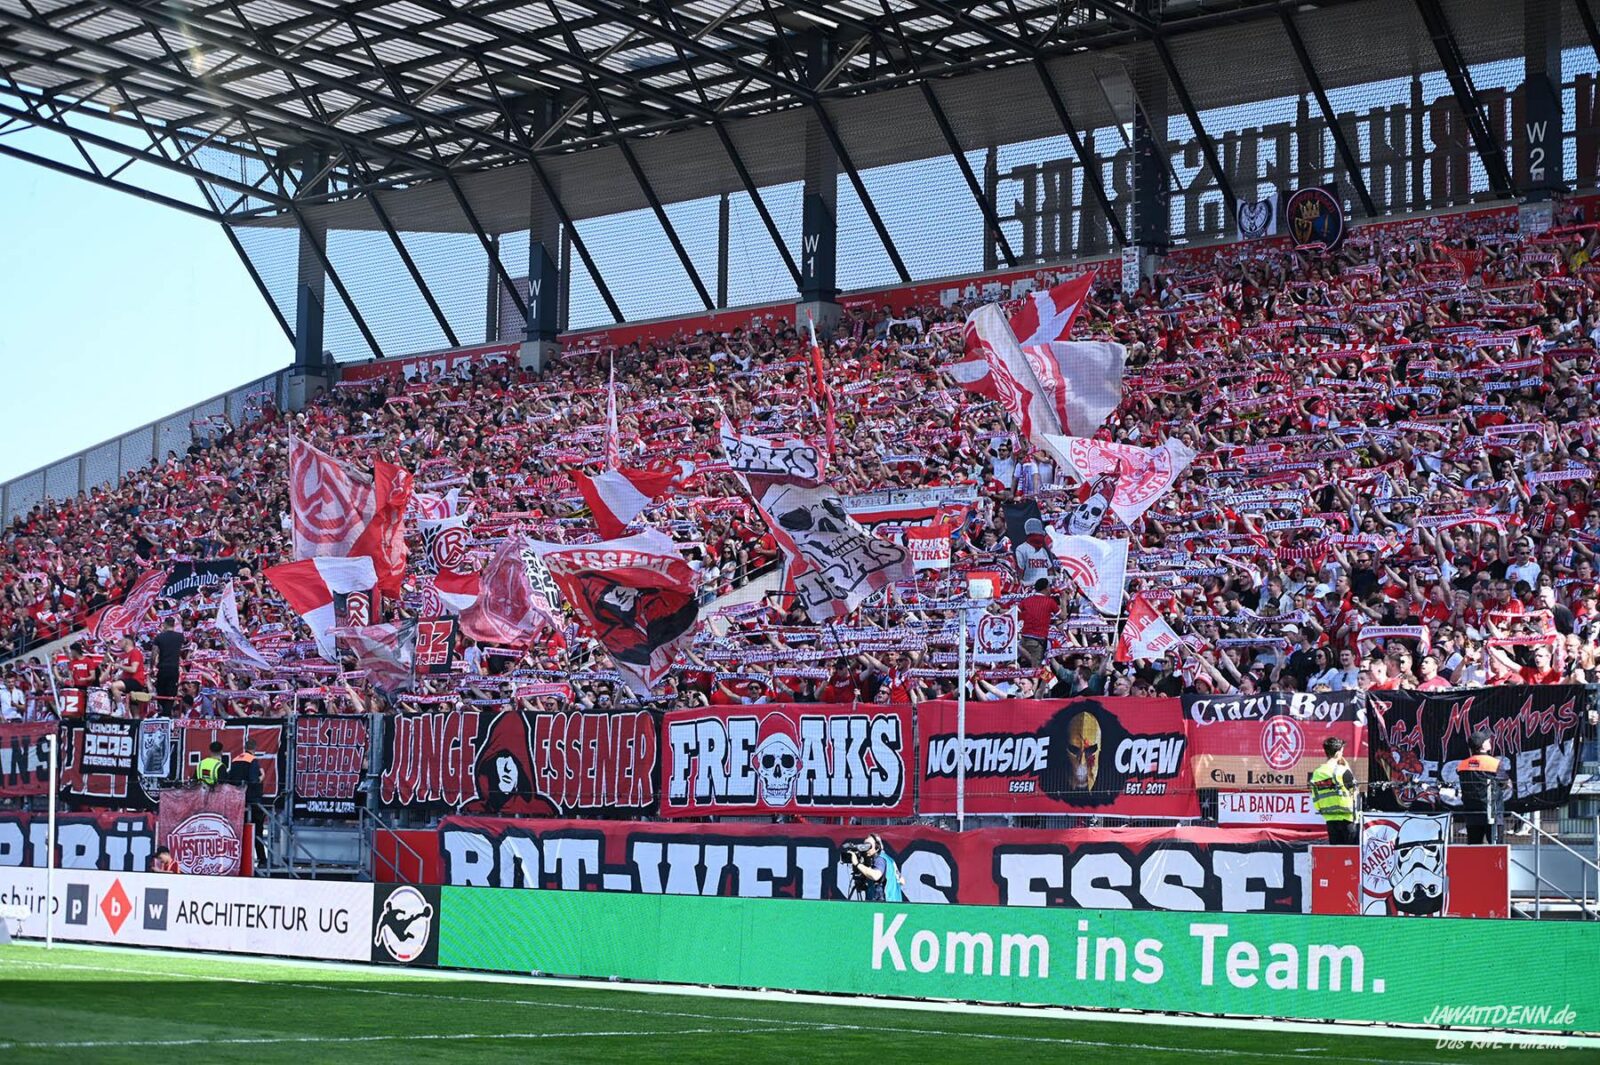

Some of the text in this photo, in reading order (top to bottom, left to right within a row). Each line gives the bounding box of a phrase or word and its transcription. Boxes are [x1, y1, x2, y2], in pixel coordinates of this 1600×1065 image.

[1526, 121, 1548, 144] W
[1530, 148, 1544, 171] 2
[804, 235, 820, 253] W
[528, 279, 542, 296] W
[908, 538, 949, 549] FREAKS
[89, 724, 130, 734] VANDALZ
[296, 717, 366, 746] SEKTION
[85, 734, 132, 757] ACAB
[927, 736, 1050, 777] NORTHSIDE
[1115, 737, 1184, 776] CREW
[83, 756, 131, 768] STERBEN NIE
[296, 745, 364, 773] STADION
[381, 711, 479, 805] JUNGE
[535, 710, 657, 808] ESSENER
[669, 714, 904, 808] FREAKS
[295, 772, 360, 799] VERBOT
[1009, 781, 1035, 793] ESSEN
[1126, 783, 1165, 795] EST. 2011
[1247, 770, 1294, 785] Leben
[1230, 795, 1310, 813] LA BANDA E
[1362, 840, 1396, 875] BANDA
[111, 898, 120, 914] b
[149, 904, 163, 919] w
[176, 901, 349, 933] ARCHITEKTUR UG
[872, 913, 1386, 993] Komm ins Team.
